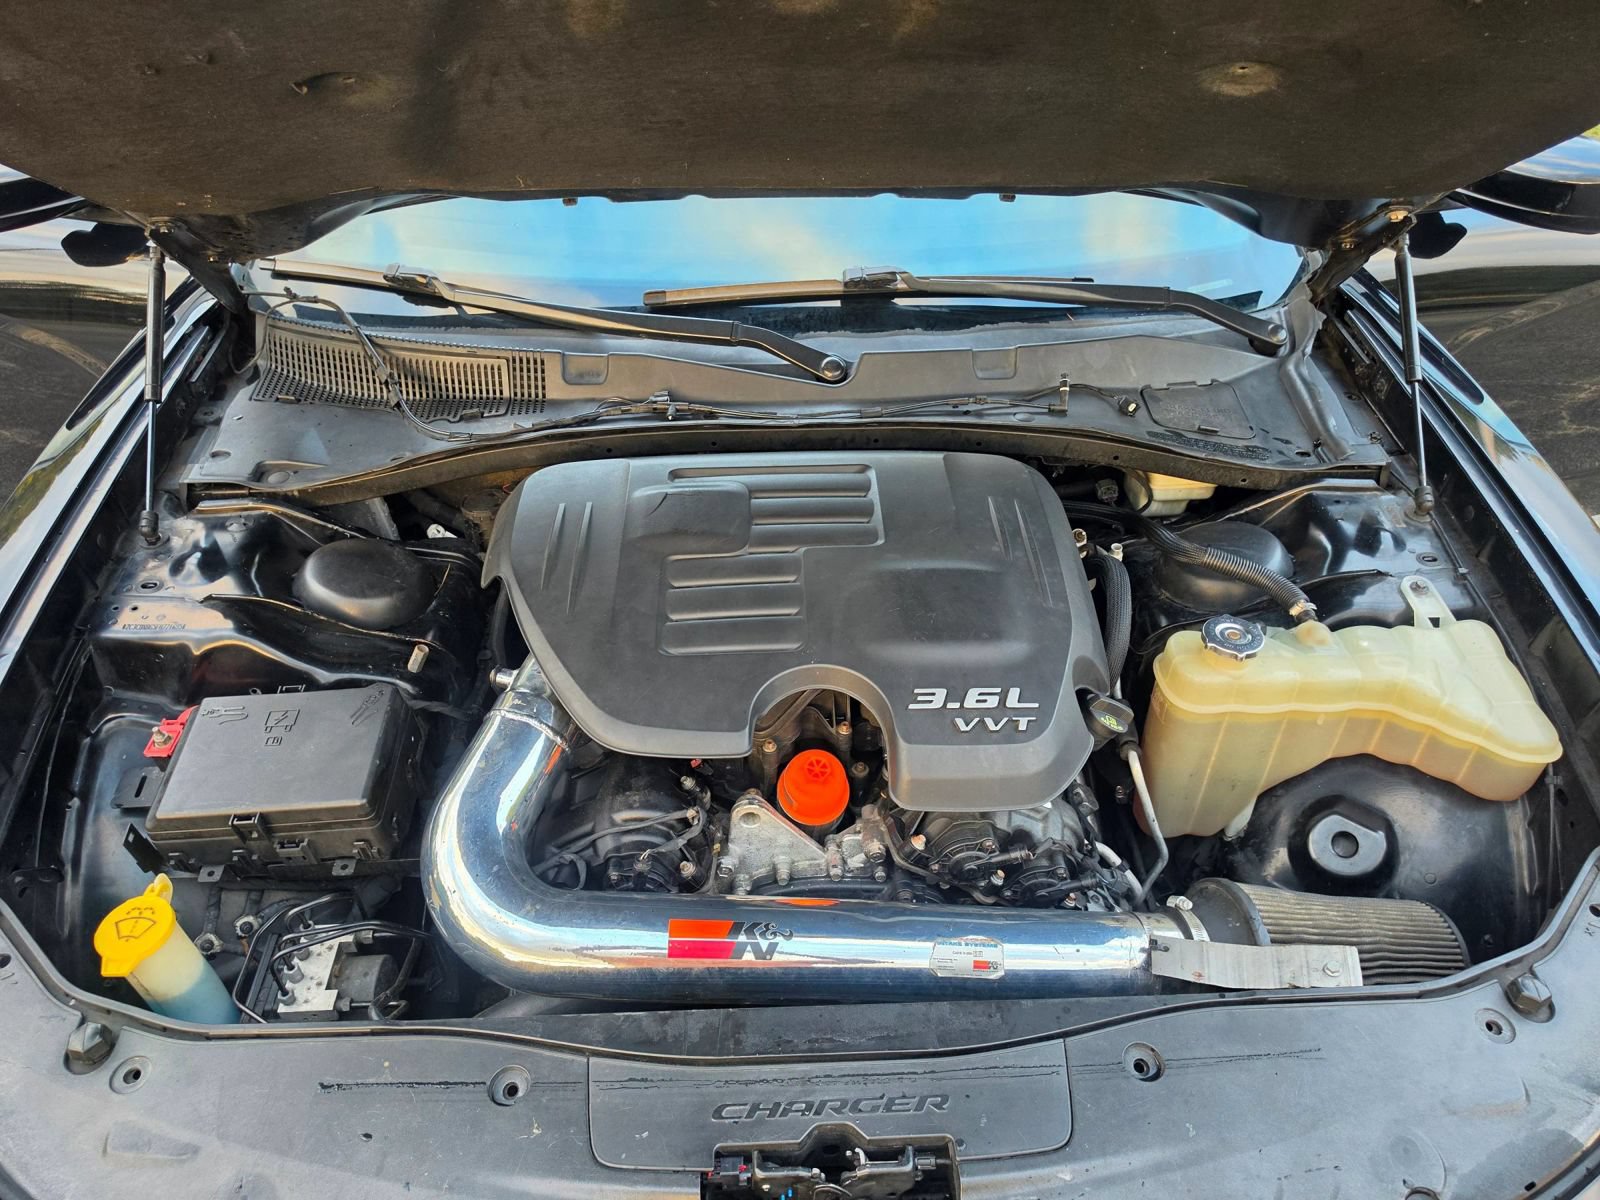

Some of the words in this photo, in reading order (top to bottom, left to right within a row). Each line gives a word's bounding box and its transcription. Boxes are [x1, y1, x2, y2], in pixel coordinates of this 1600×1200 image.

[907, 687, 1040, 710] 3.6L
[953, 716, 1037, 732] VVT
[711, 1094, 950, 1121] CHARGER
